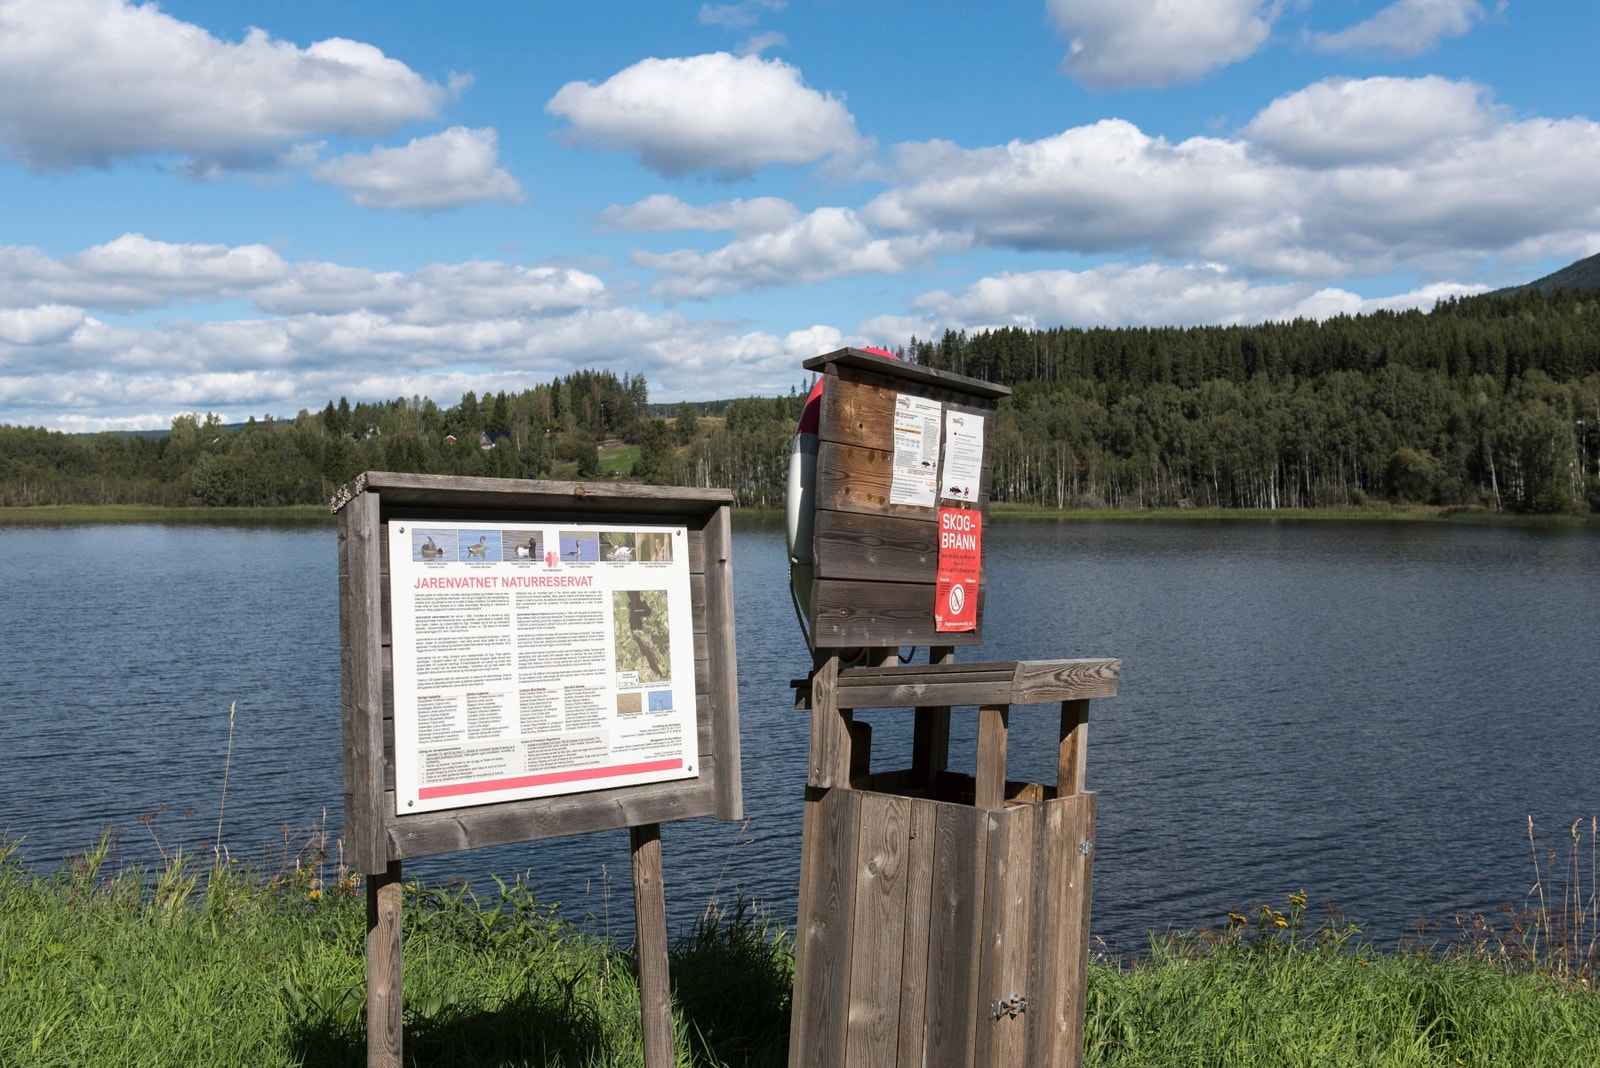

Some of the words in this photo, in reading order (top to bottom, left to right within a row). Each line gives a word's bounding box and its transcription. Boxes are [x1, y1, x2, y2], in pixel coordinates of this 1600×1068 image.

[942, 513, 976, 531] SKOG-
[941, 532, 976, 550] BRANN
[414, 577, 498, 589] JARENVATNET
[501, 576, 593, 588] NATURRESERVAT
